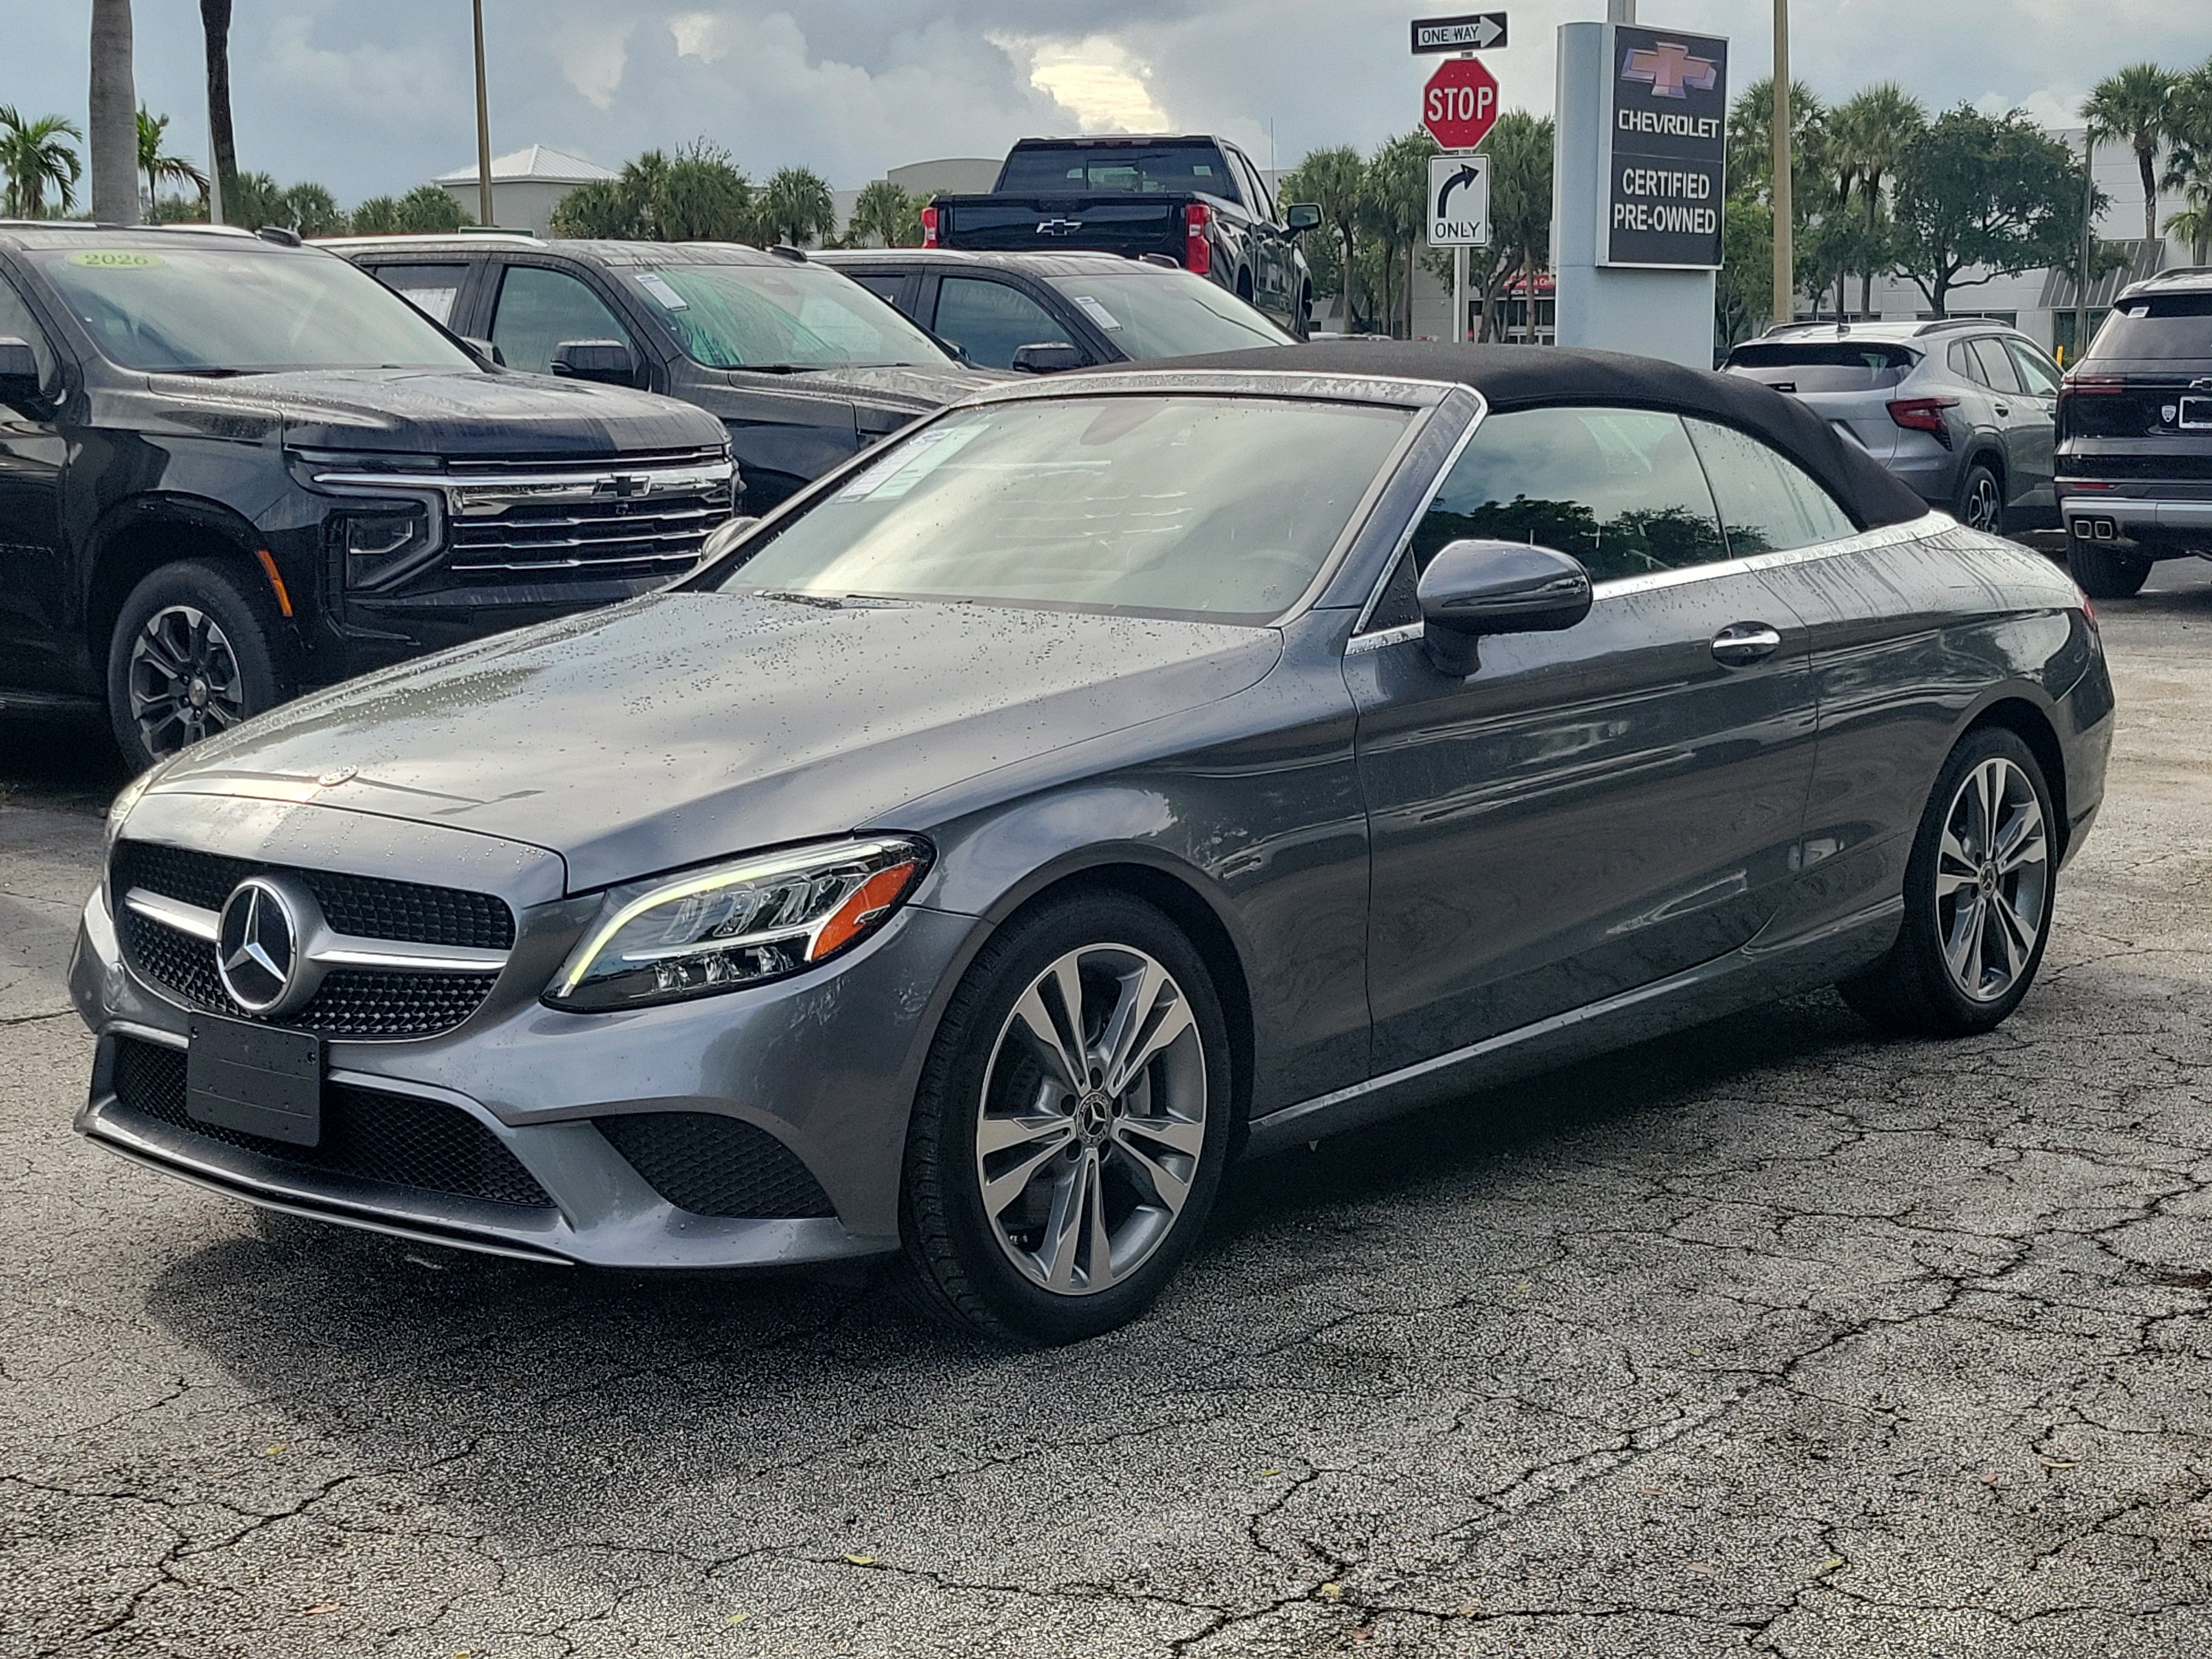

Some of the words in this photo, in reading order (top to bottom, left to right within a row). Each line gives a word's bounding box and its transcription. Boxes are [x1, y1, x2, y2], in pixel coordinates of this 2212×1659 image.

[1422, 29, 1449, 43] ONE
[1454, 25, 1479, 41] WAY
[1427, 87, 1493, 121] STOP
[1618, 109, 1720, 139] CHEVROLET
[1623, 168, 1710, 200] CERTIFIED
[1435, 221, 1481, 238] ONLY
[1614, 203, 1716, 234] PRE-OWNED
[85, 254, 148, 265] 2026
